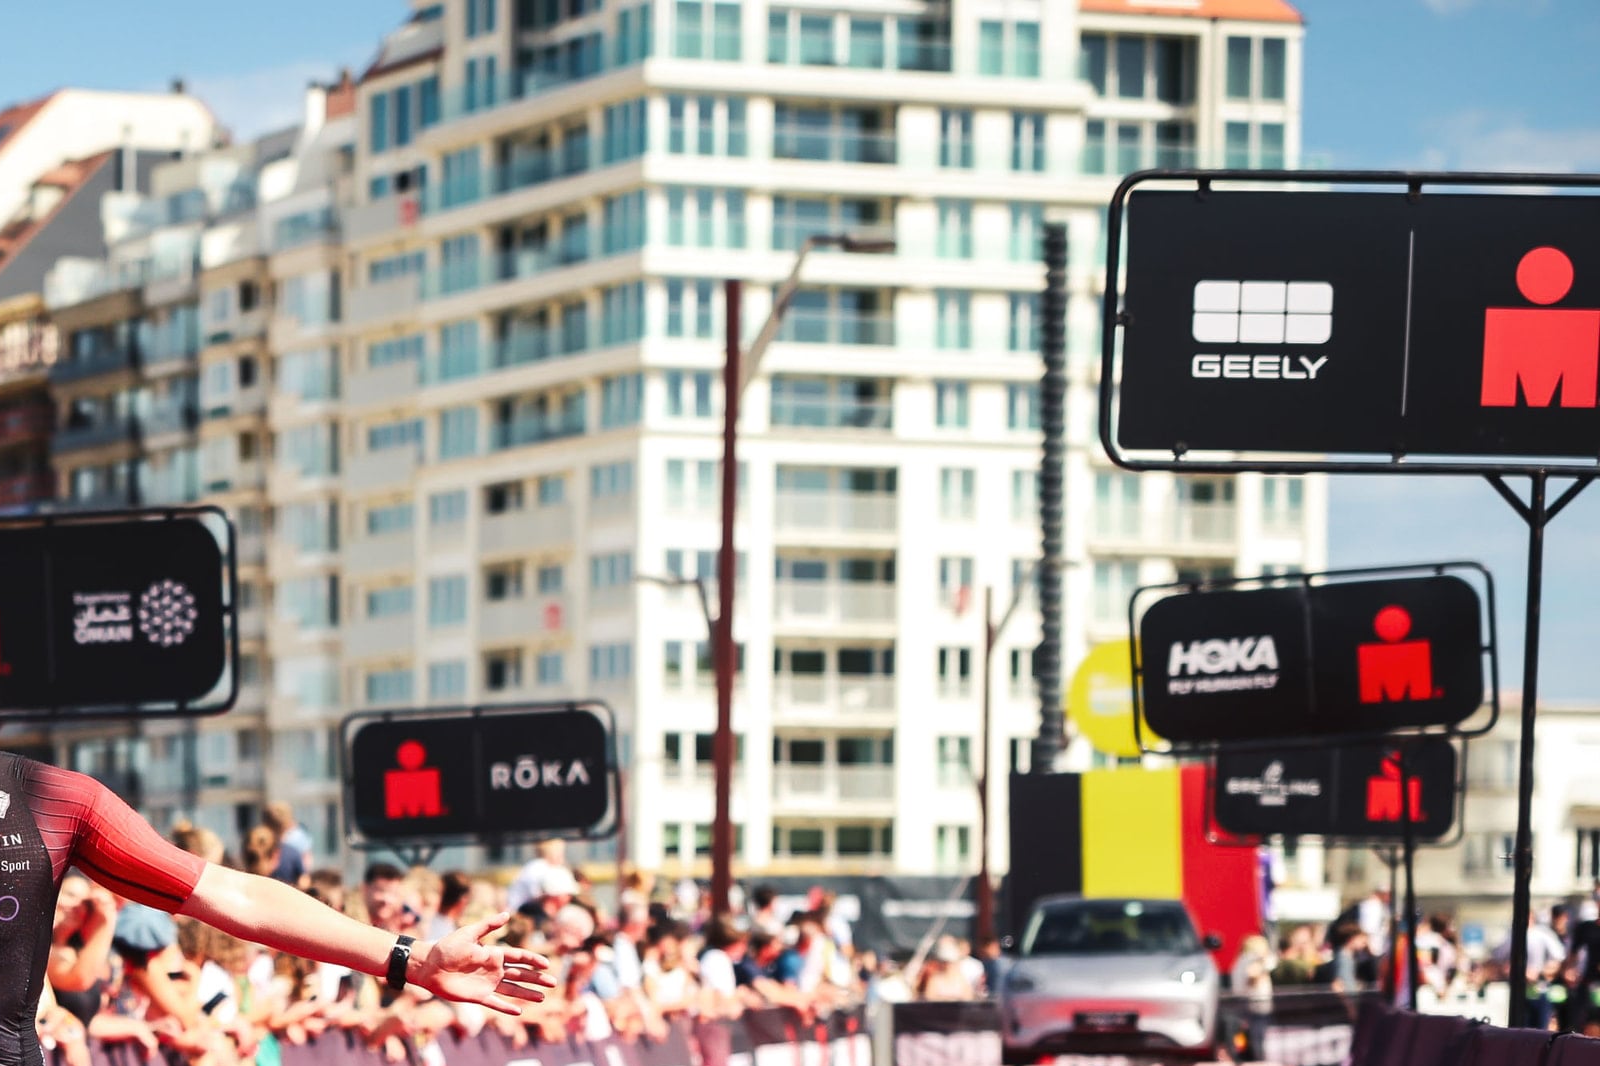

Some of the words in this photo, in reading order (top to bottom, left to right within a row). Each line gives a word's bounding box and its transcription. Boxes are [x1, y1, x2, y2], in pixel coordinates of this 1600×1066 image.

[1191, 354, 1329, 380] GEELY
[1168, 634, 1280, 677] HOKA
[0, 859, 31, 874] Sport
